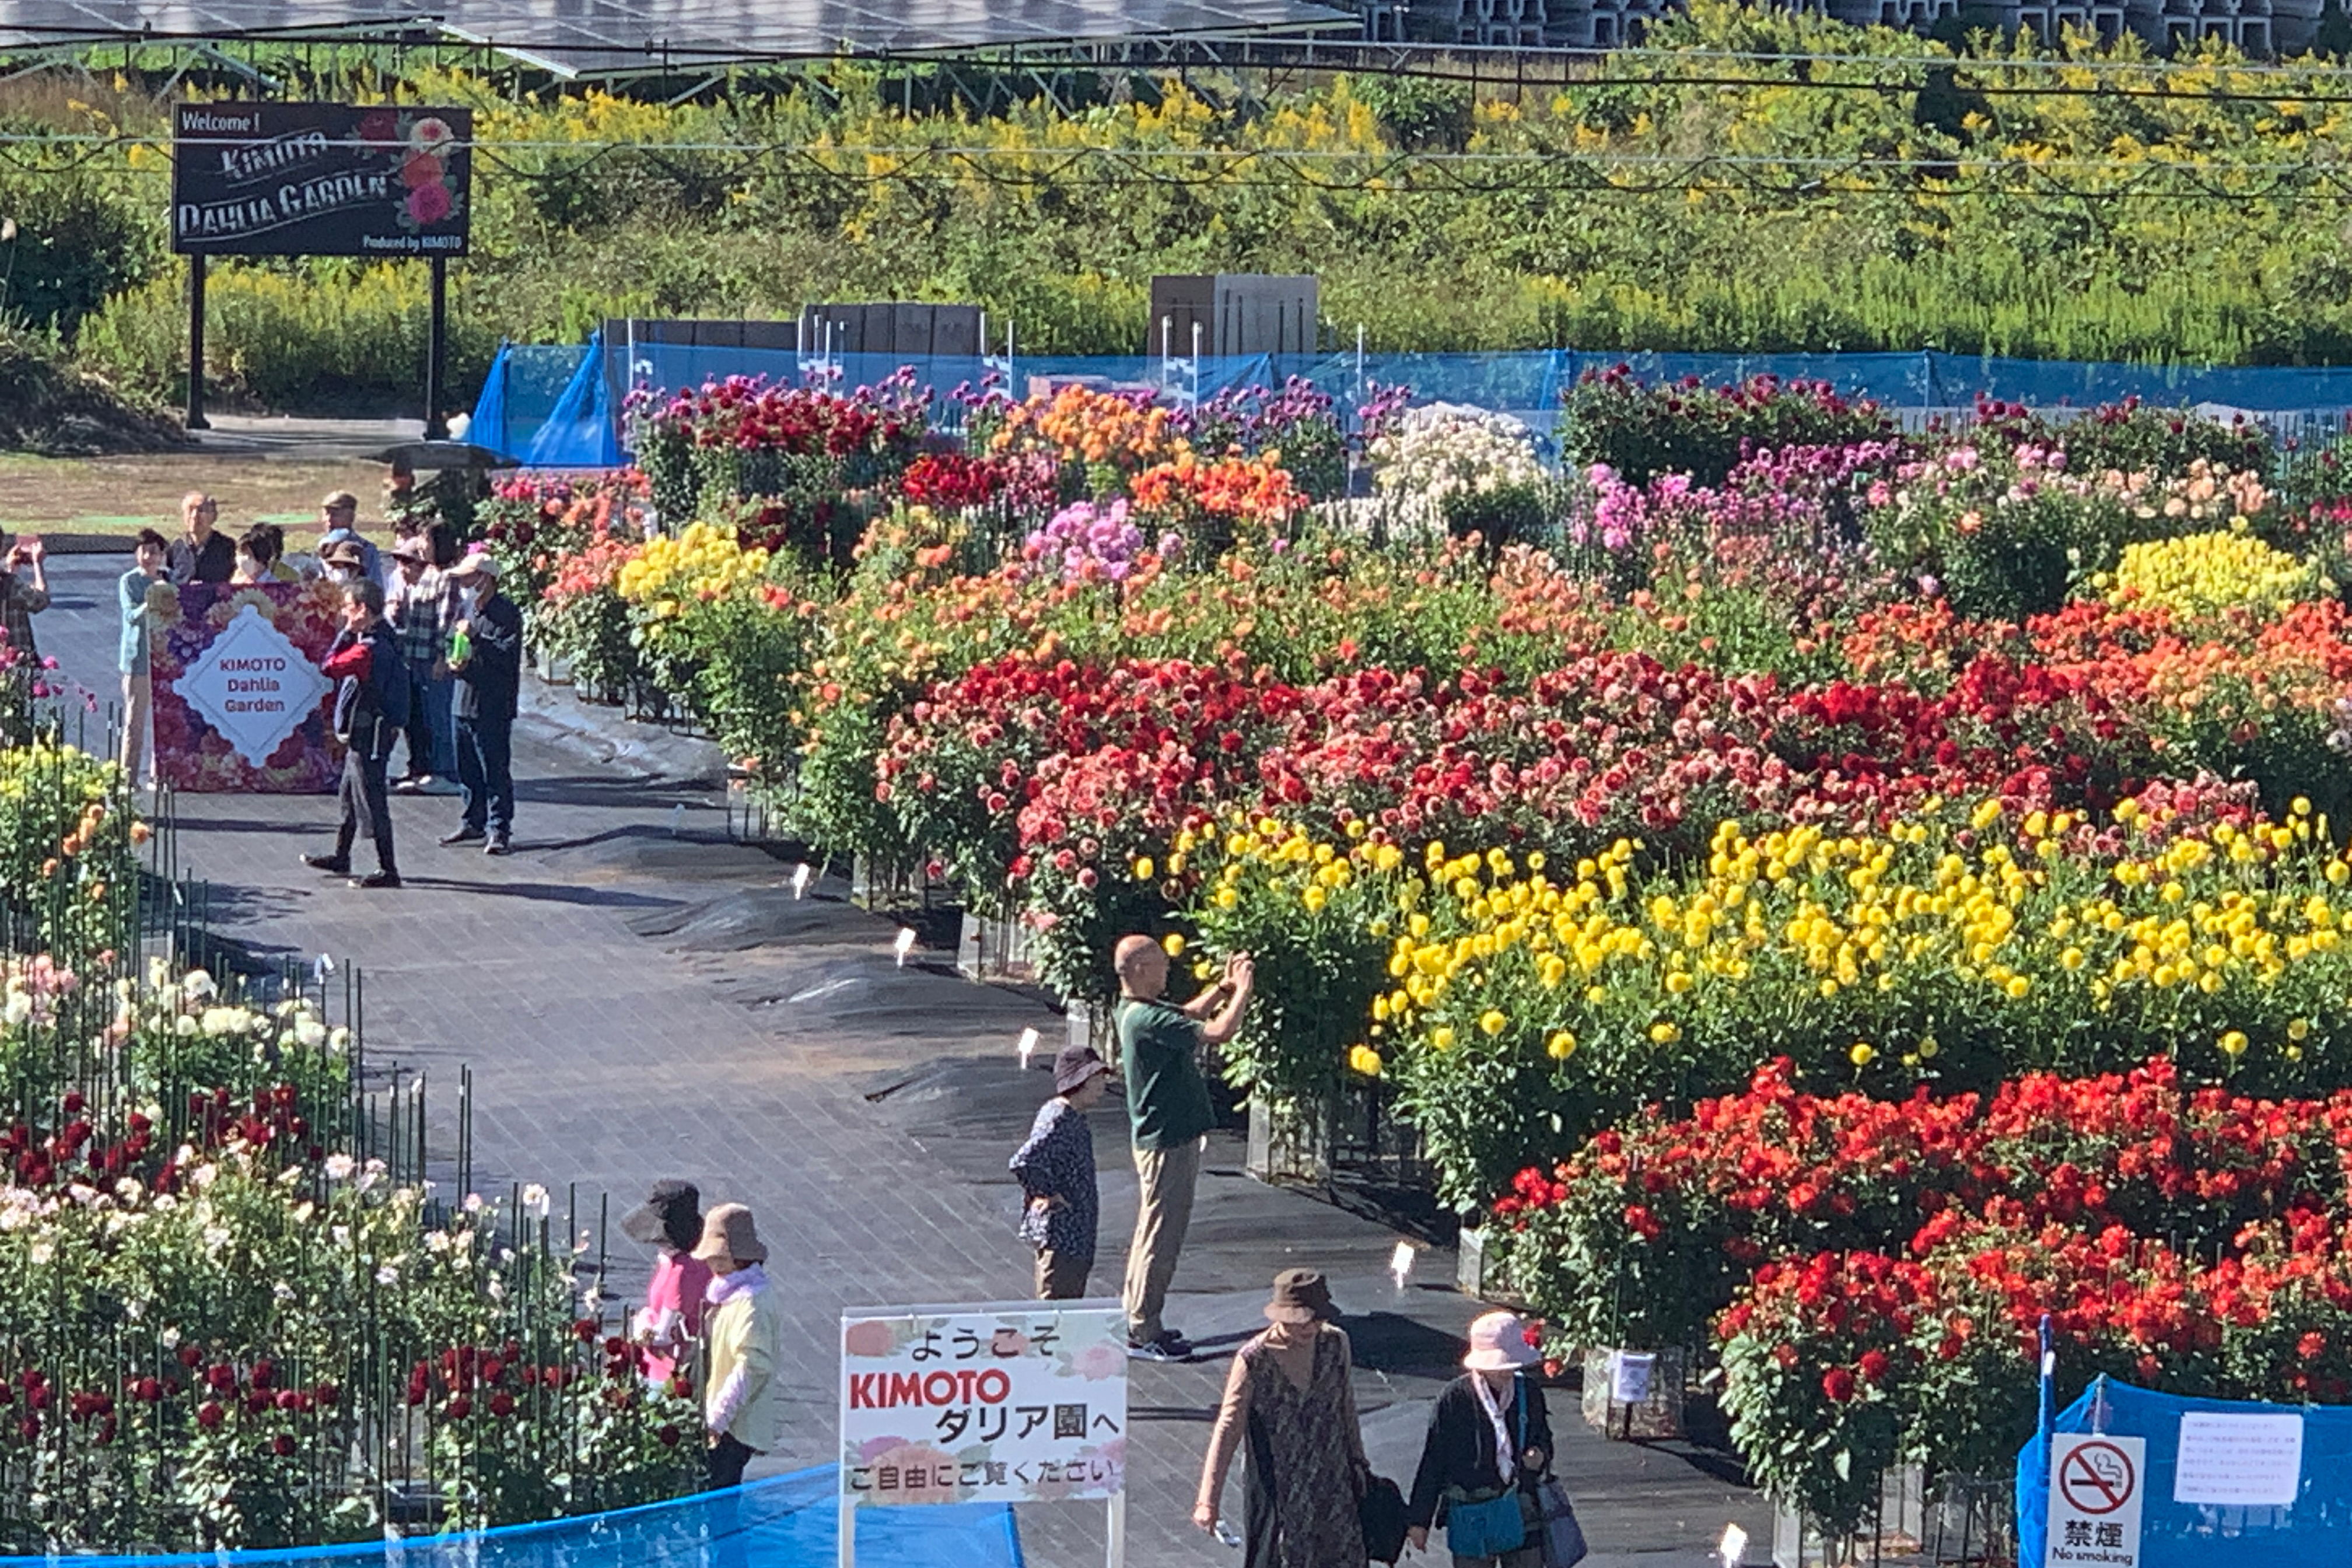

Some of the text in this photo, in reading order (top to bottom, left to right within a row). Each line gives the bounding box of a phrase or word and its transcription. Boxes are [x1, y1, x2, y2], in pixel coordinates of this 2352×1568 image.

[182, 111, 251, 131] Welcome
[220, 657, 286, 671] KIMOTO
[228, 677, 280, 692] Dahlia
[225, 698, 285, 713] Garden
[911, 1325, 1060, 1362] ようこそ
[849, 1368, 1011, 1409] KIMOTO
[935, 1403, 1119, 1444] ダリア園へ
[850, 1460, 1115, 1491] ご自由にご覧ください
[2064, 1520, 2124, 1548] 禁煙
[2052, 1547, 2133, 1566] No smoking
